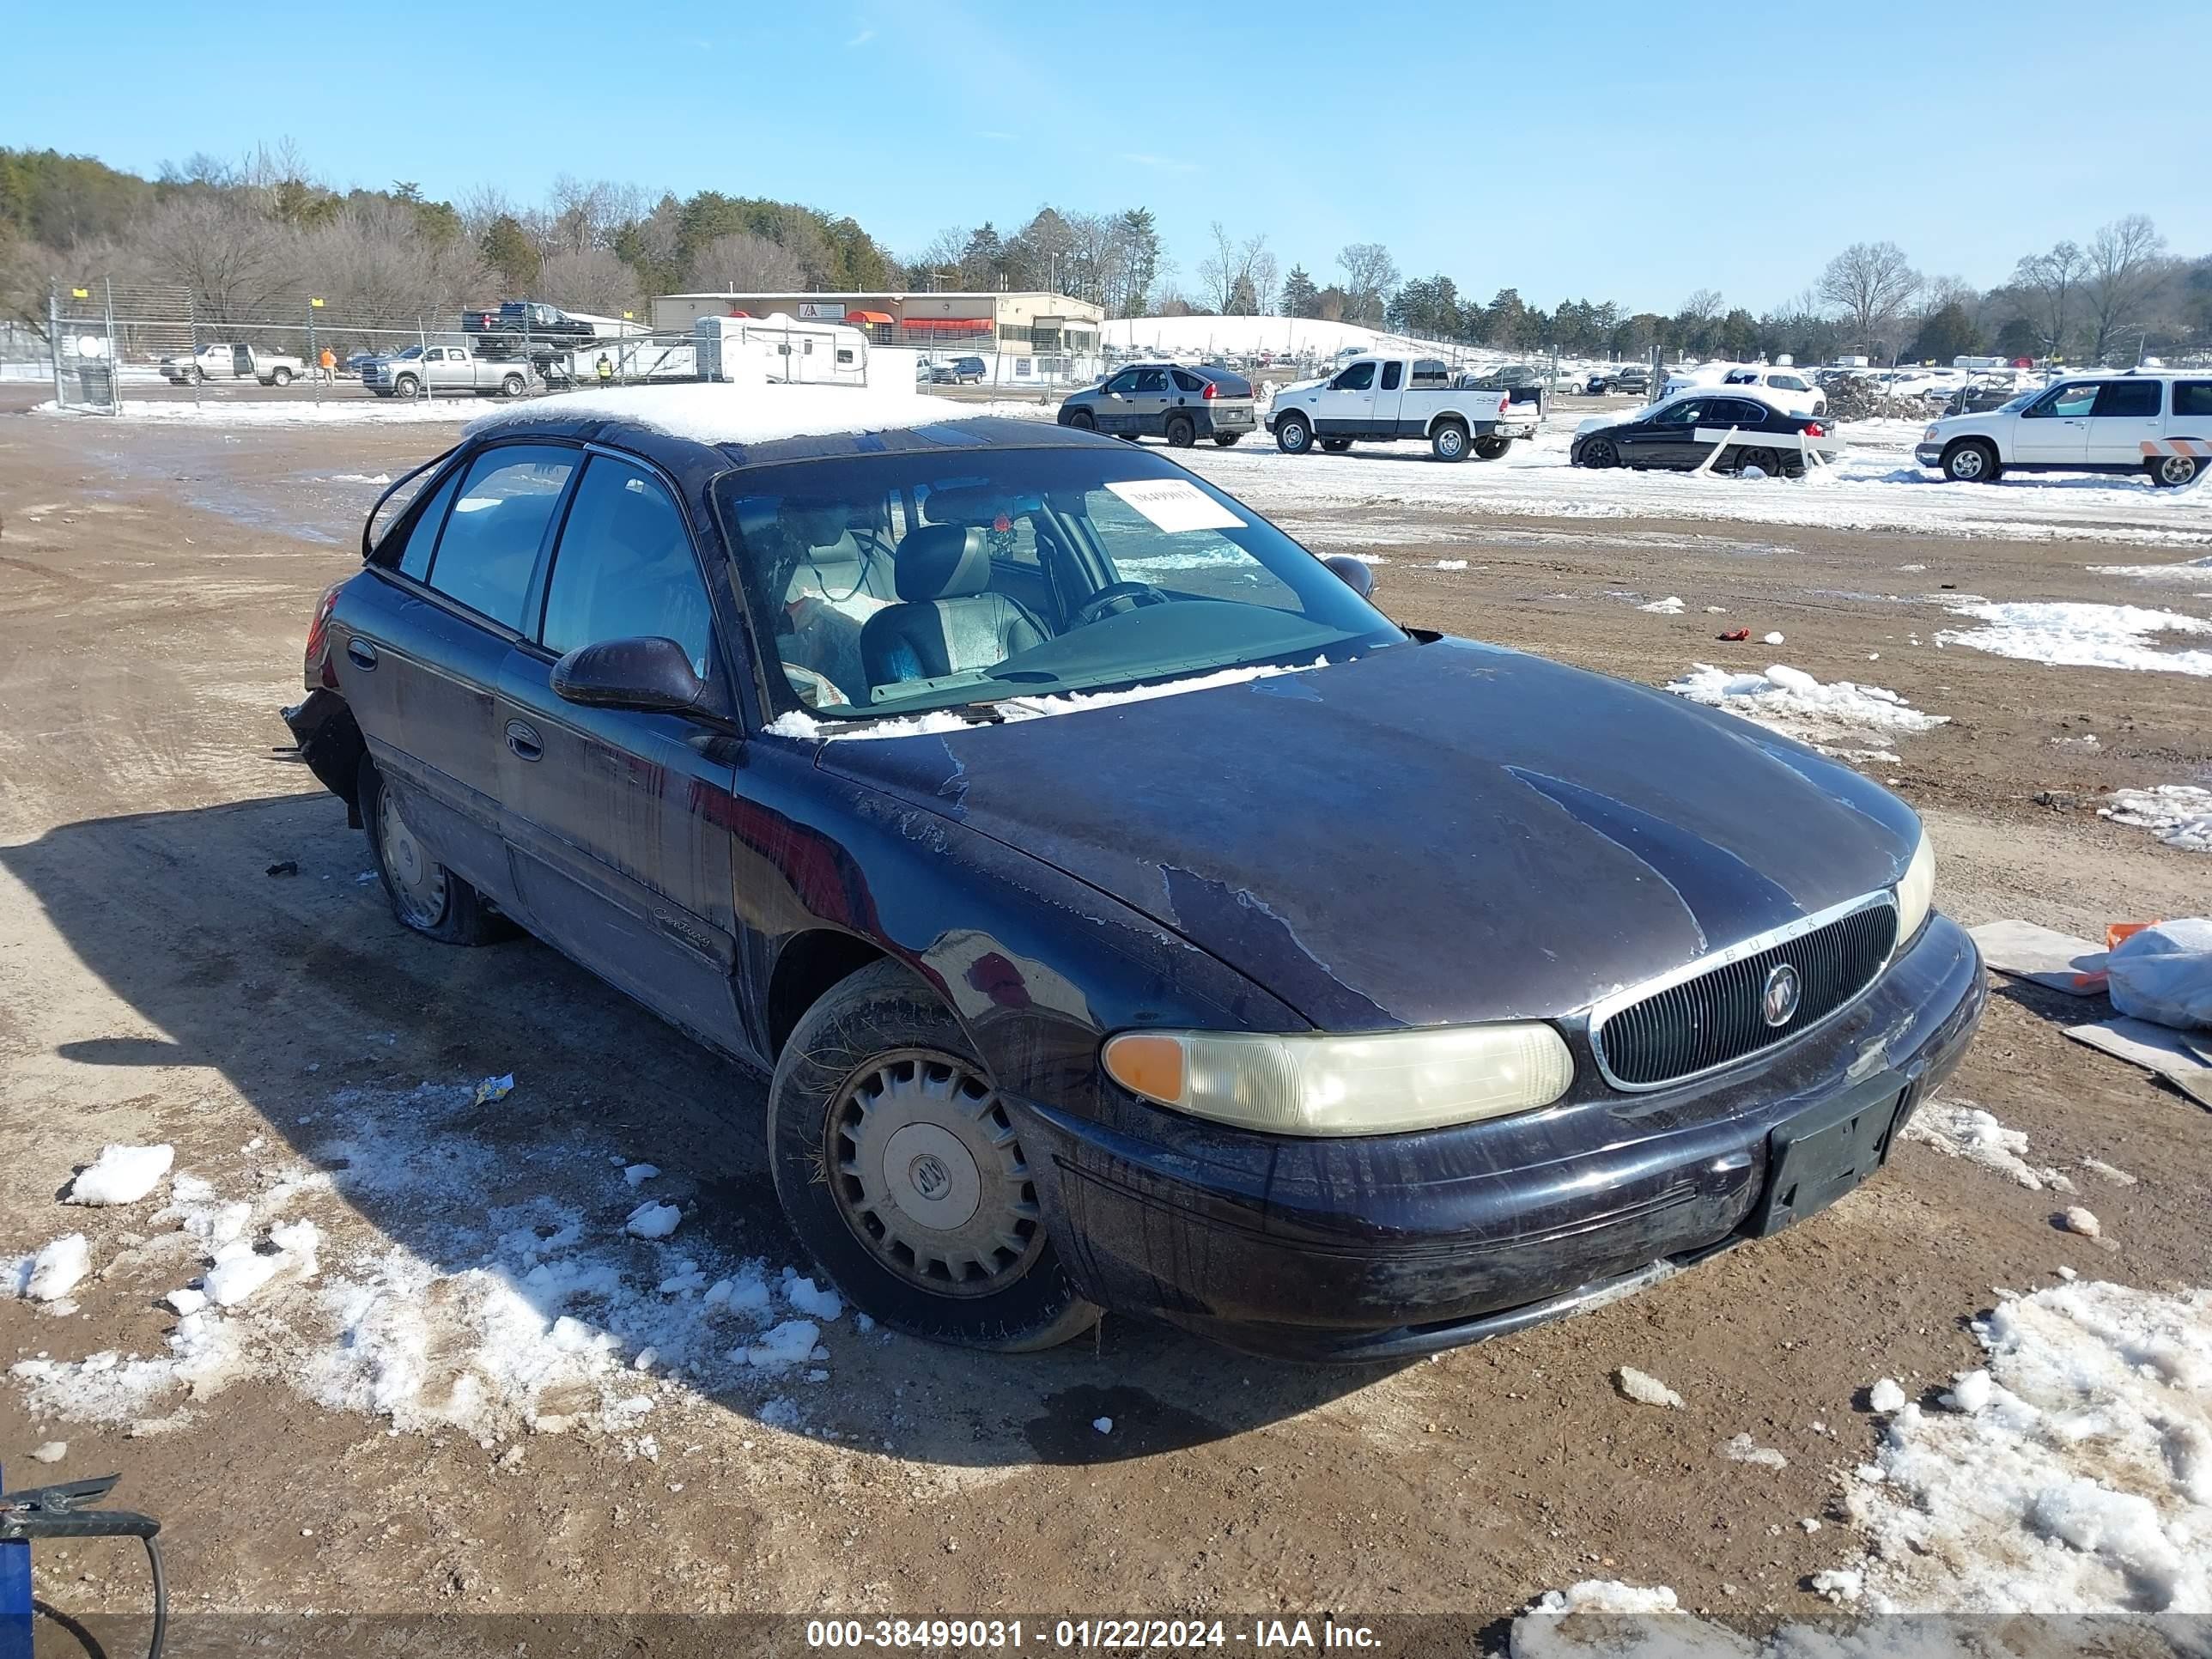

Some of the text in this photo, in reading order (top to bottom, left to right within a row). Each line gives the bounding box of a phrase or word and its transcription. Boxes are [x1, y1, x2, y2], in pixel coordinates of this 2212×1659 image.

[1130, 490, 1199, 502] 38499031
[653, 907, 711, 947] Century
[1724, 917, 1817, 962] BUICK
